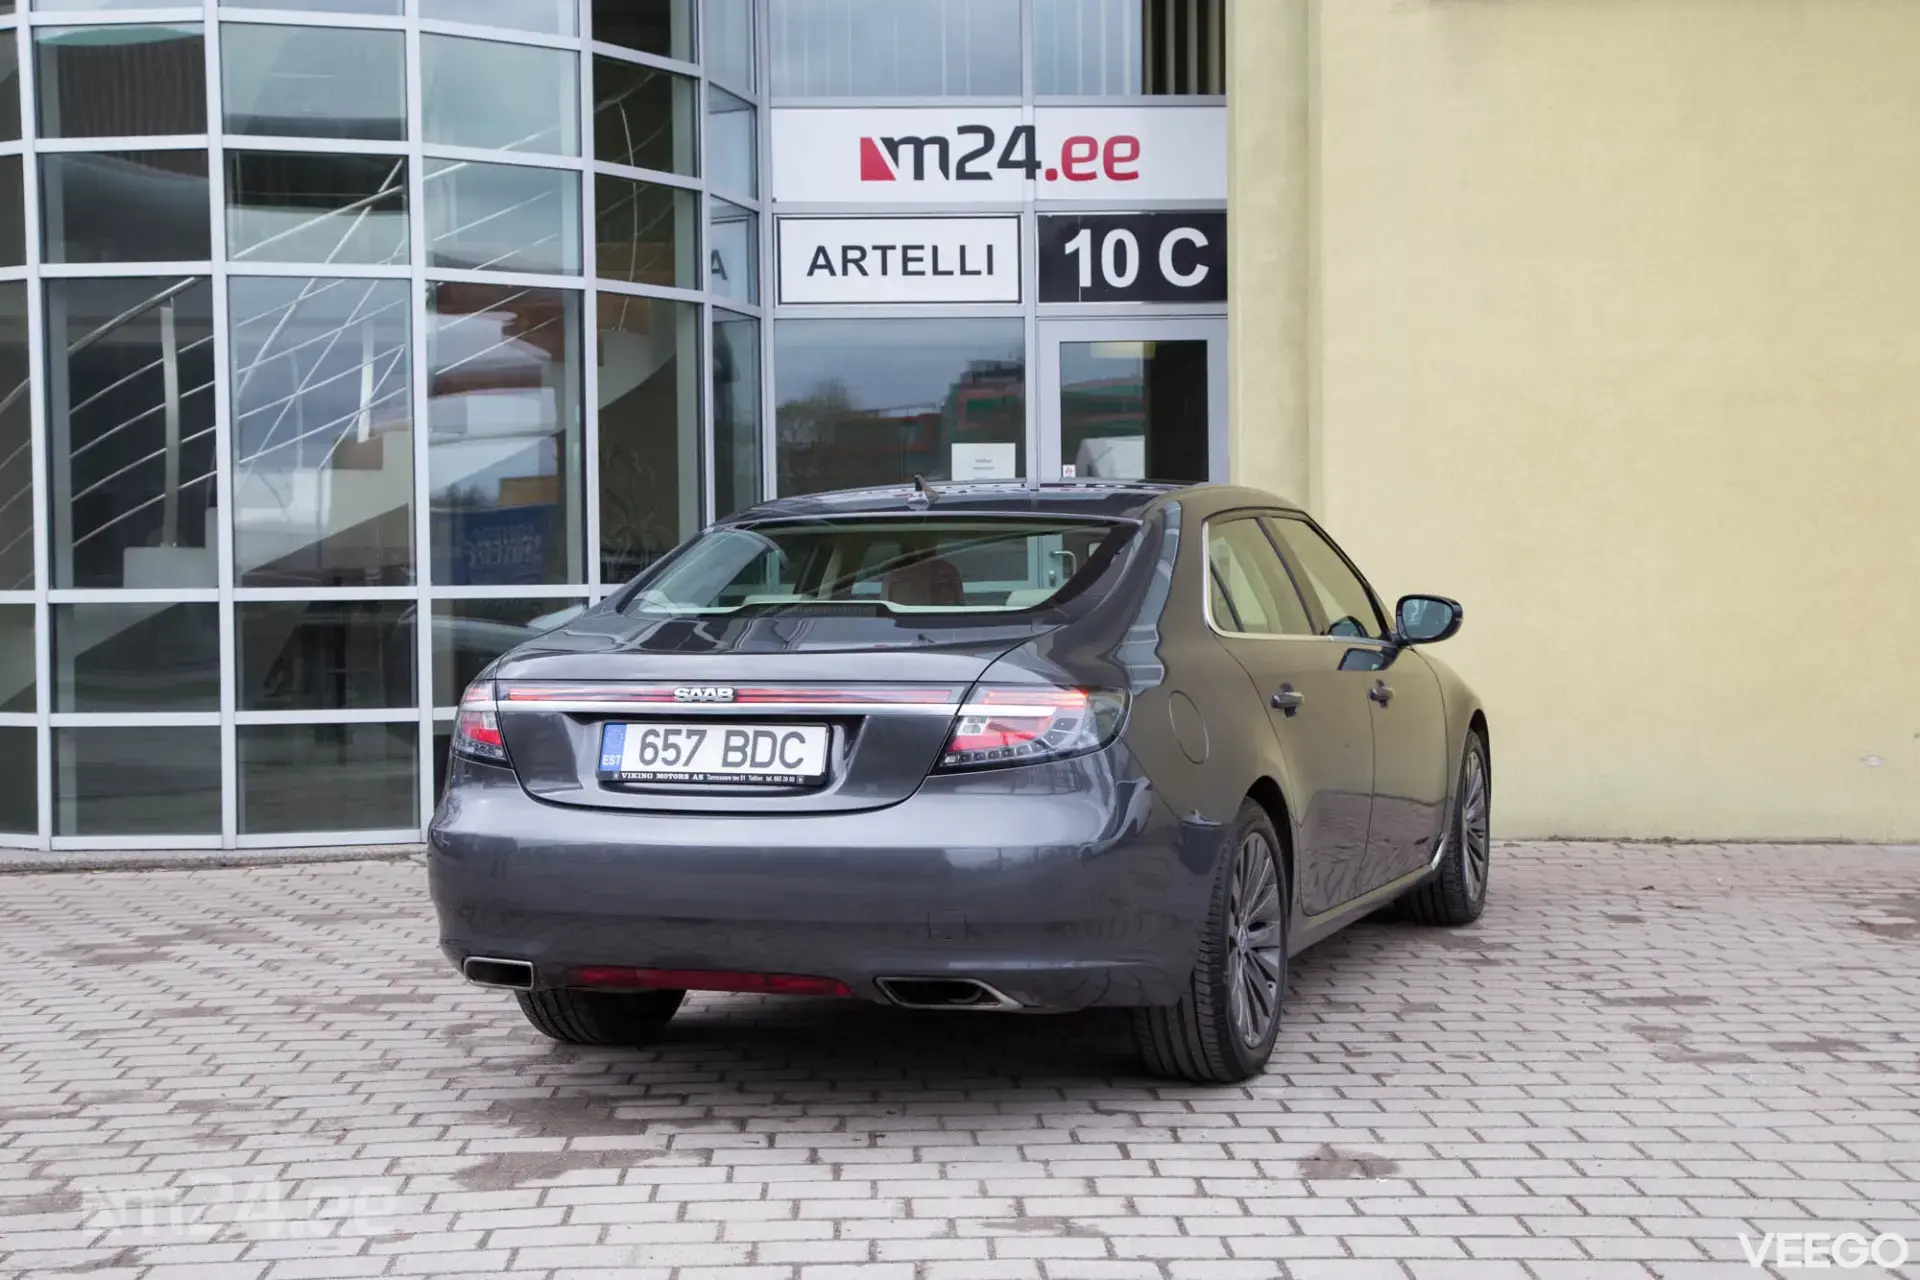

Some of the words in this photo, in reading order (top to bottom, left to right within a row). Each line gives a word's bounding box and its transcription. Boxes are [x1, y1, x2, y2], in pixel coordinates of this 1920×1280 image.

[880, 124, 1141, 182] m24.ee
[806, 243, 995, 277] ARTELLI
[1064, 228, 1140, 288] 10
[1158, 227, 1210, 288] C
[673, 687, 735, 702] SAAB
[602, 754, 621, 766] EST
[638, 728, 708, 767] 657
[721, 729, 806, 769] BDC
